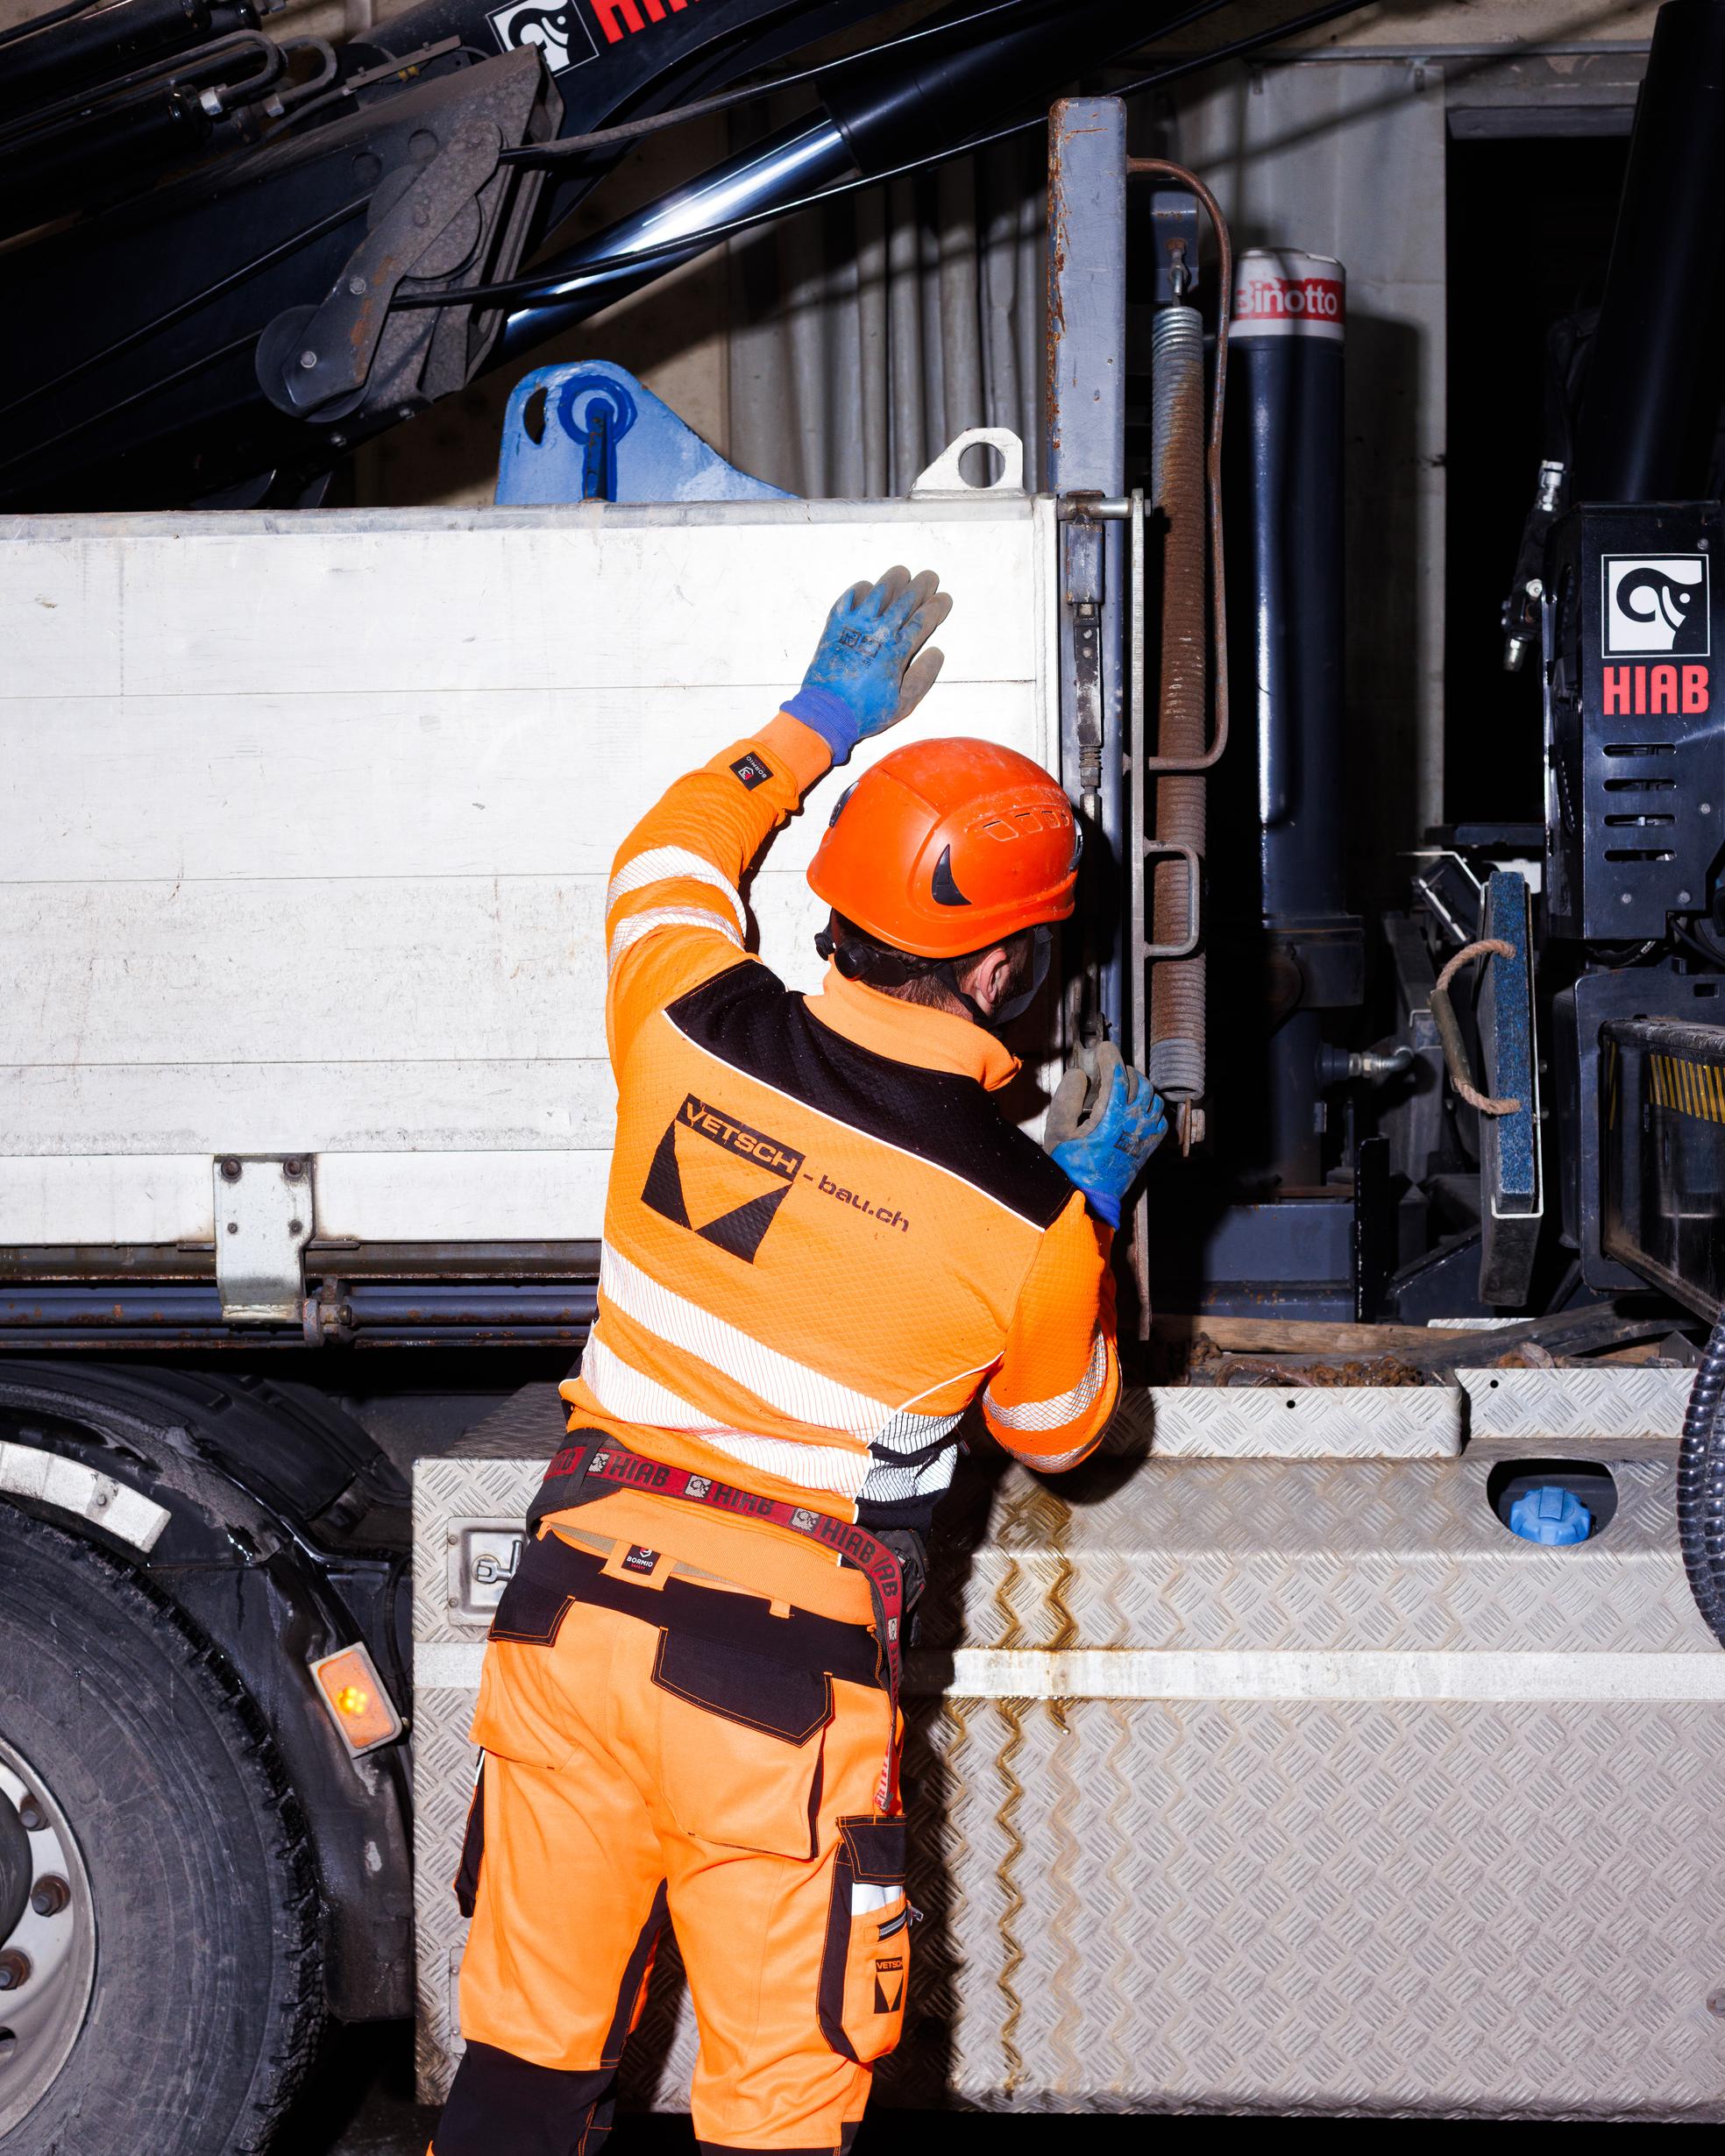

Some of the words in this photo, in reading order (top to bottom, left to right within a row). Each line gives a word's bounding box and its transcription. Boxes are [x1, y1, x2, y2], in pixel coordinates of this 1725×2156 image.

[1602, 664, 1710, 716] HIAB
[746, 755, 768, 779] BORMIO
[685, 1102, 799, 1175] VETSCH
[608, 1454, 671, 1487] HIAB
[820, 1517, 876, 1566] HIAB
[626, 1556, 654, 1568] BORMIO
